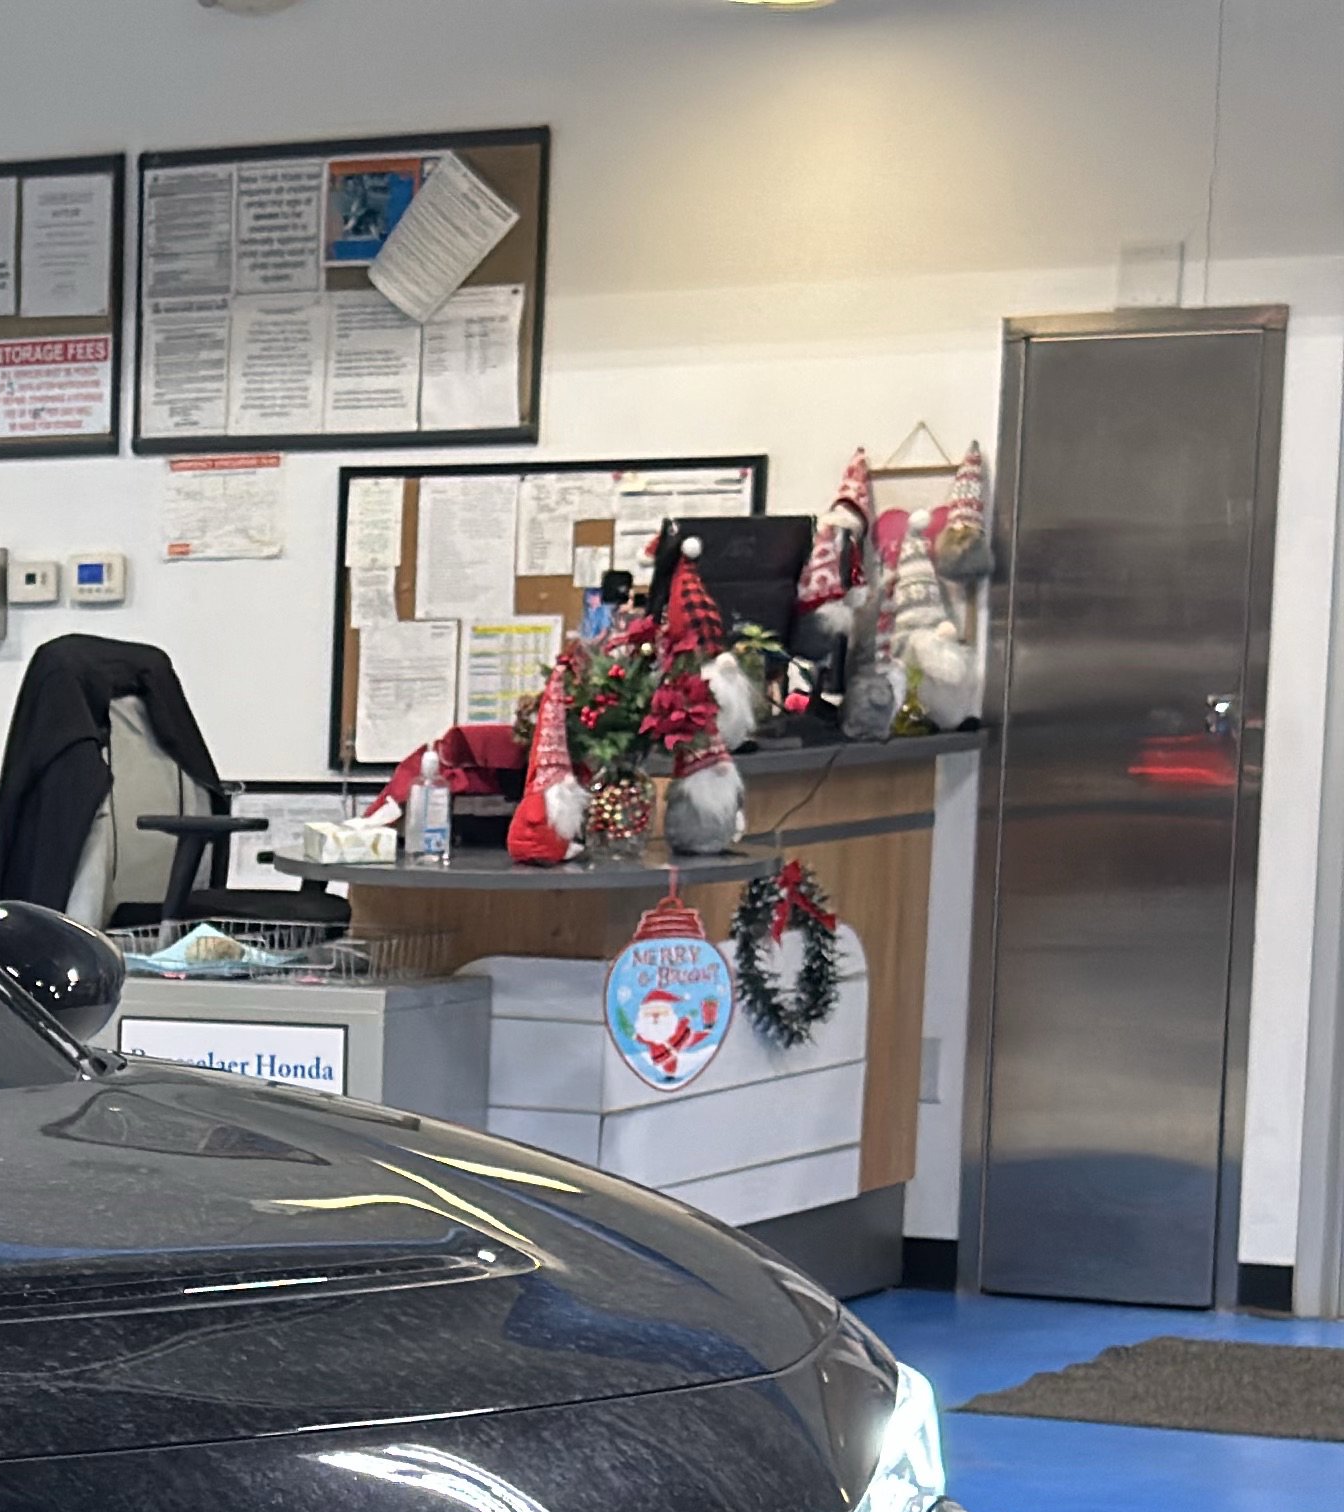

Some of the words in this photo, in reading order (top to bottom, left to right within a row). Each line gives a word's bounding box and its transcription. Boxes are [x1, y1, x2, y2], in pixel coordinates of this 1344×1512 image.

[67, 341, 106, 361] FEES
[632, 946, 701, 967] MERRY
[256, 1054, 334, 1081] Honda
